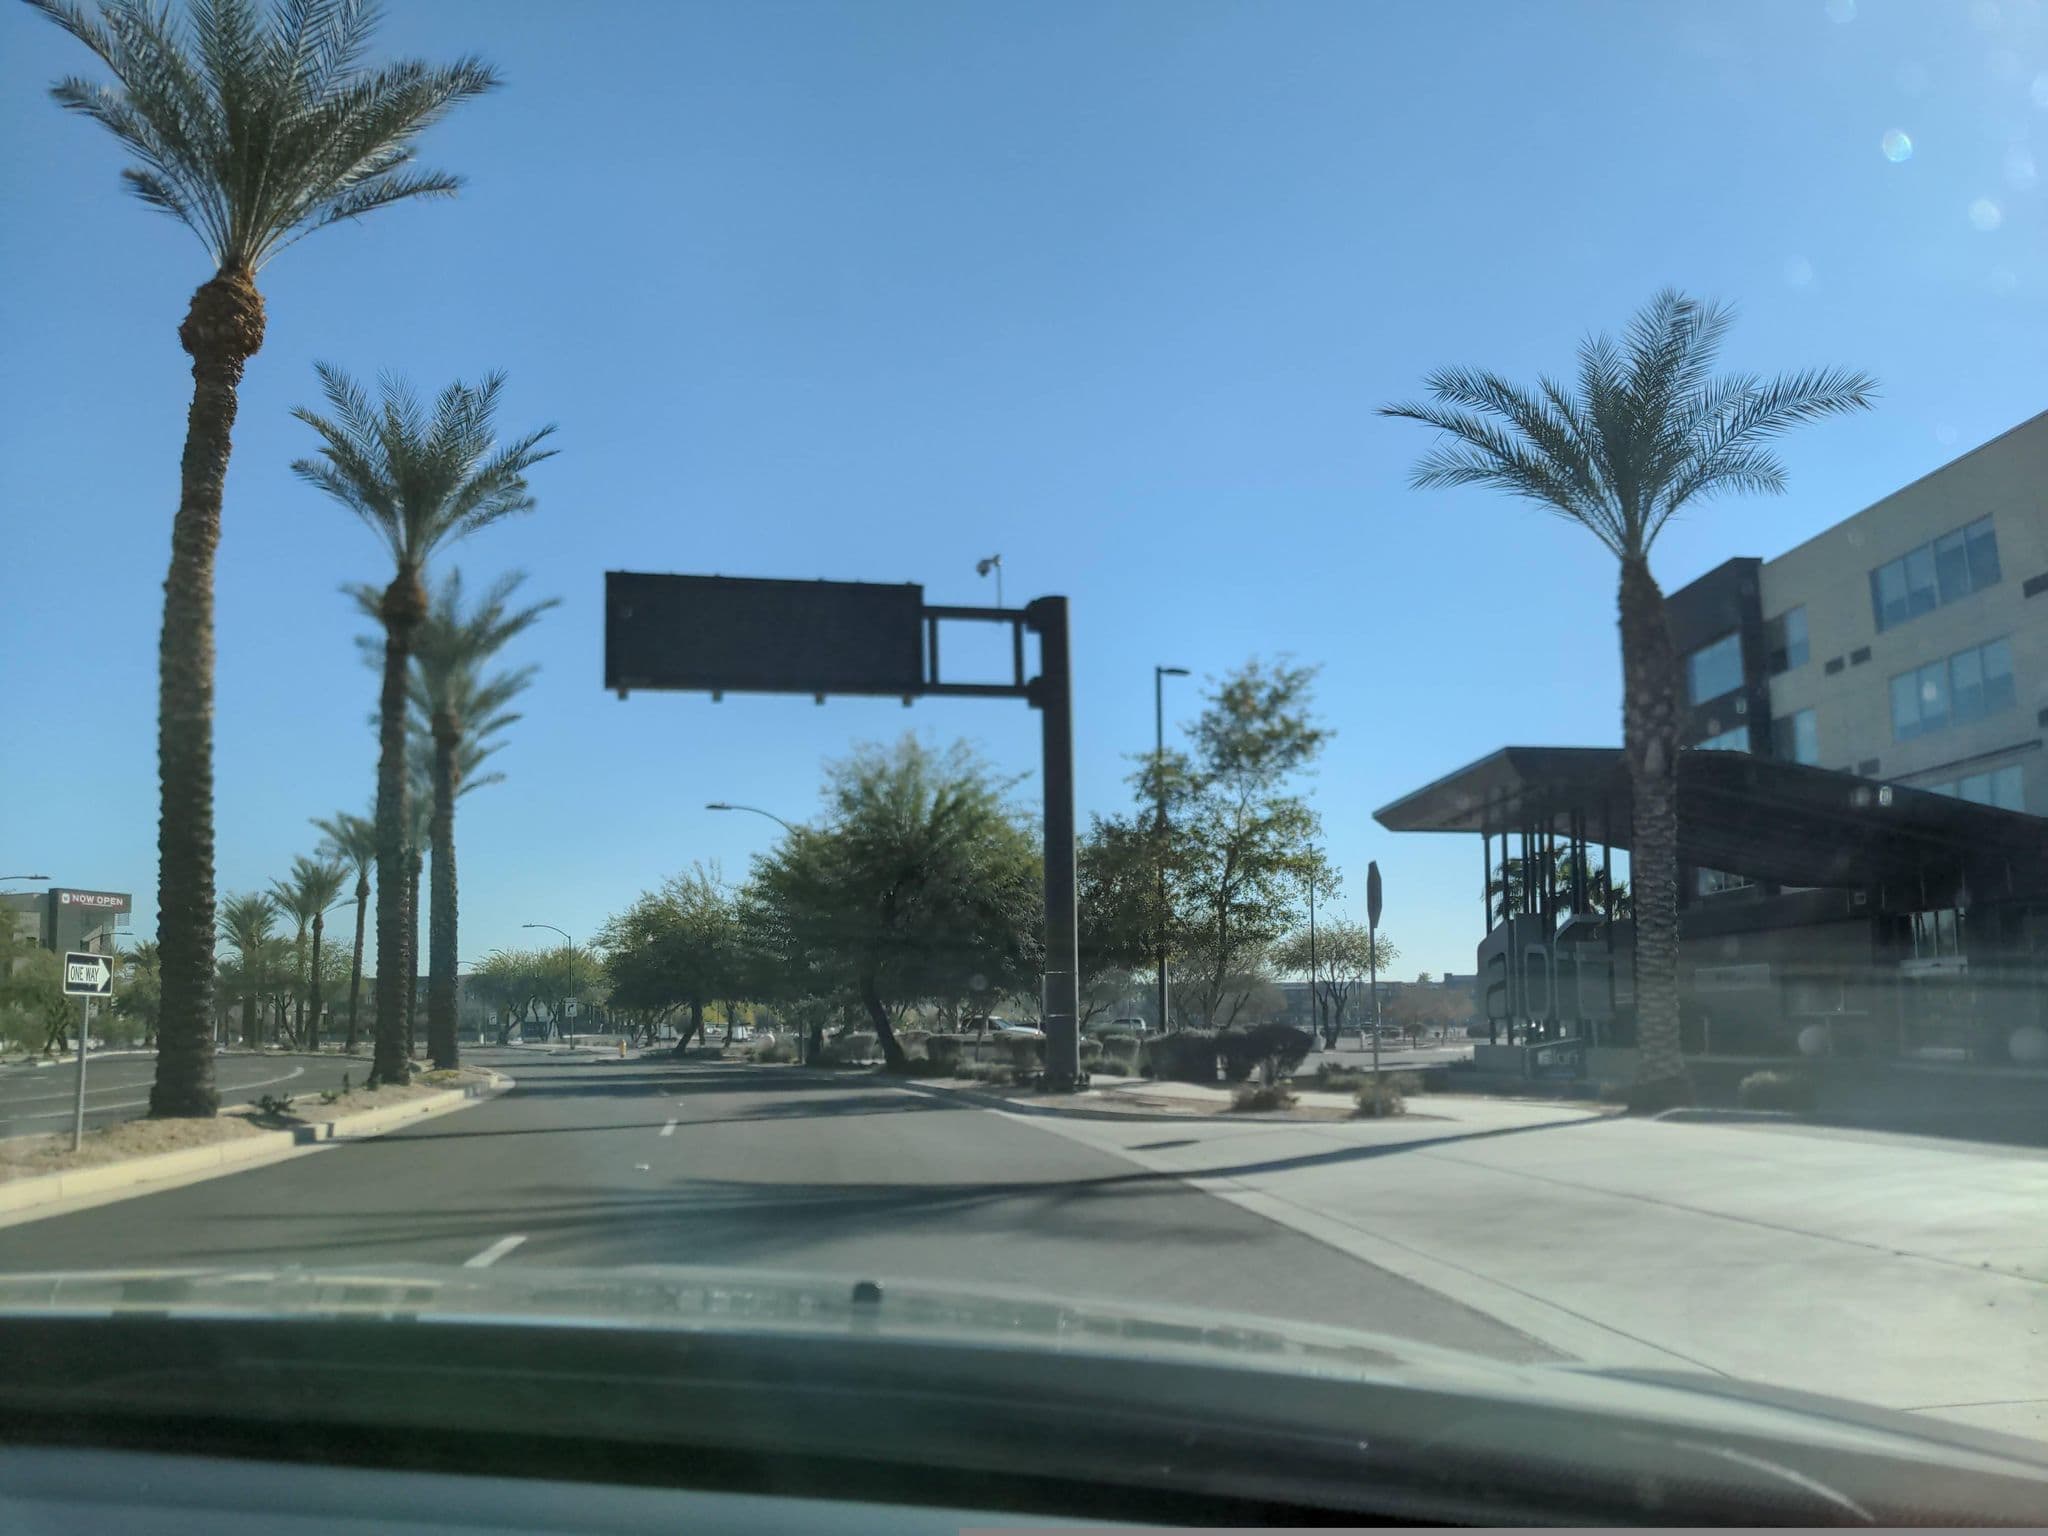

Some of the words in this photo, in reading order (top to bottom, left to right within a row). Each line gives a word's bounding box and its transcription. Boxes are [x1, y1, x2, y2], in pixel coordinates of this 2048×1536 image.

[72, 894, 94, 904] NOW
[97, 896, 123, 906] OPEN
[70, 965, 84, 980] ONE
[85, 967, 99, 982] WAY
